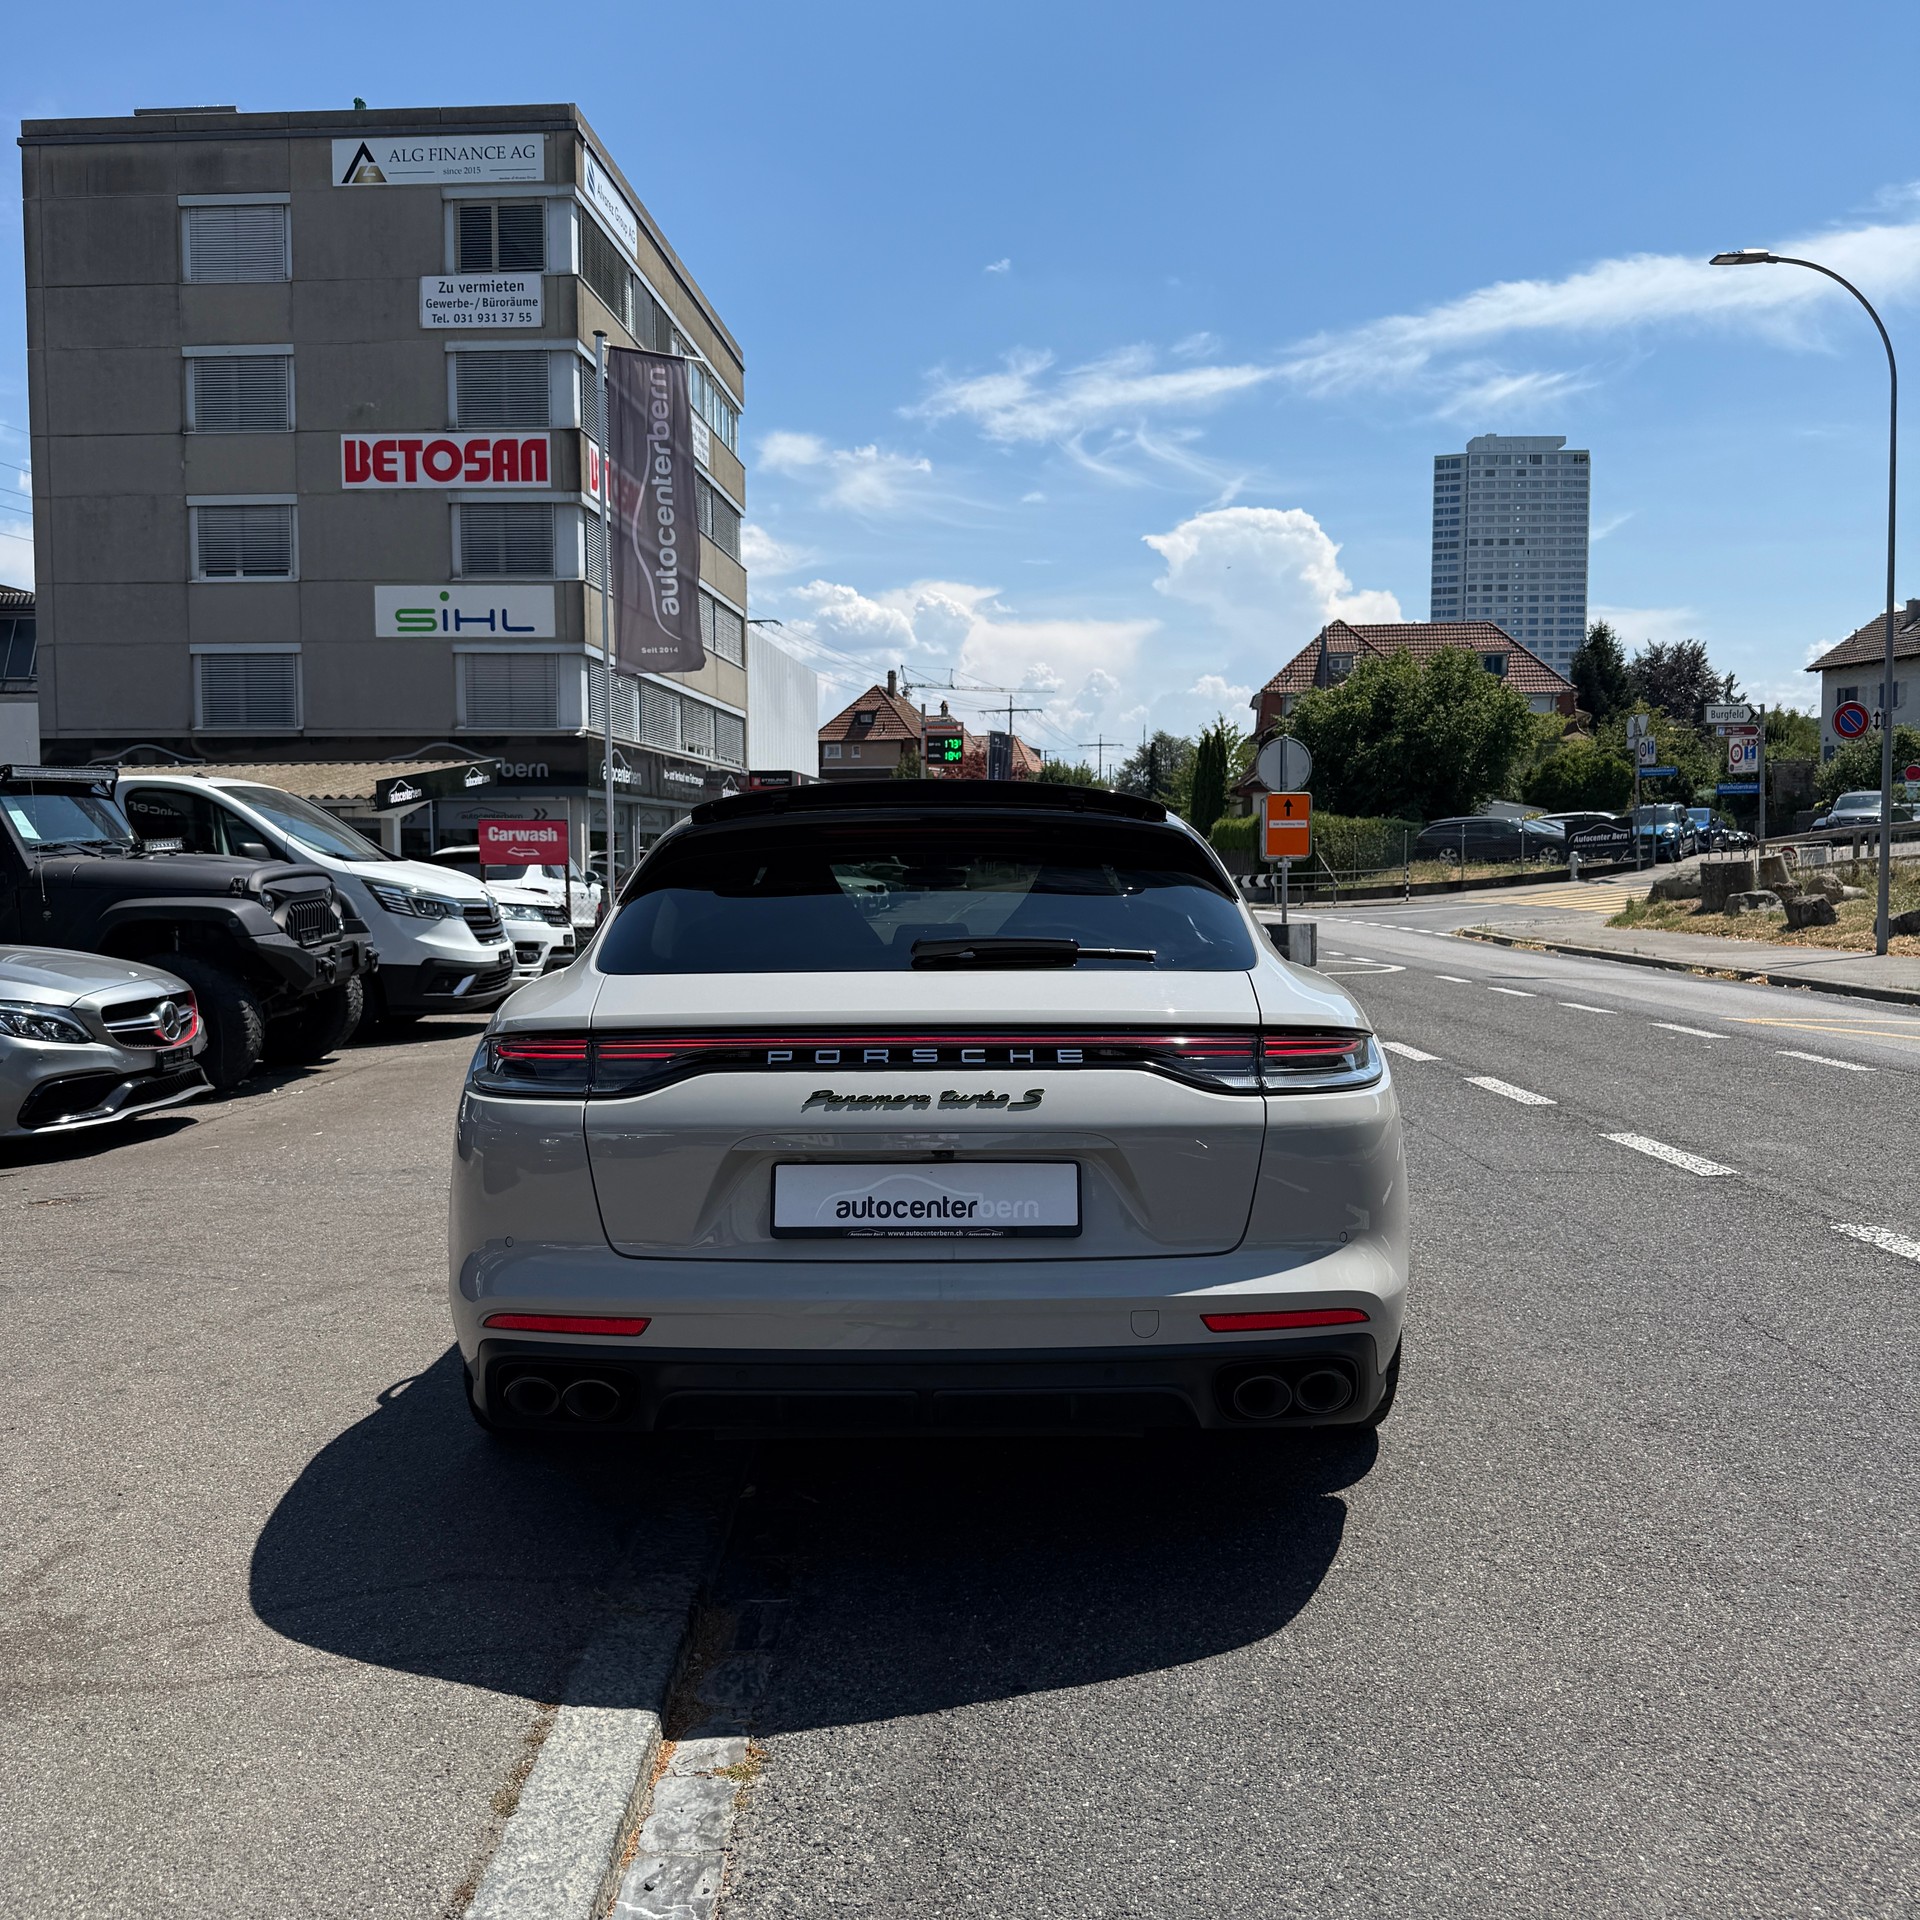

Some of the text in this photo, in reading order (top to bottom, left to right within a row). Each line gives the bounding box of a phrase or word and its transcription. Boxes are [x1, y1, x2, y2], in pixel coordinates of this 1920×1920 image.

[389, 144, 536, 163] ALG FINANCE AG
[443, 166, 481, 175] since 2015
[438, 280, 525, 293] Zu vermieten
[482, 297, 538, 308] Büroräume
[432, 312, 532, 323] Tel. 031 931 37 55
[344, 439, 547, 482] BETOSAN
[647, 367, 680, 616] autocenterbern
[1710, 710, 1745, 720] Burgfeld
[488, 826, 558, 842] Carwash
[1573, 832, 1628, 843] Autocenter Bern
[767, 1049, 1084, 1064] PORSCHE
[803, 1089, 932, 1105] Panamera
[1008, 1088, 1046, 1104] S
